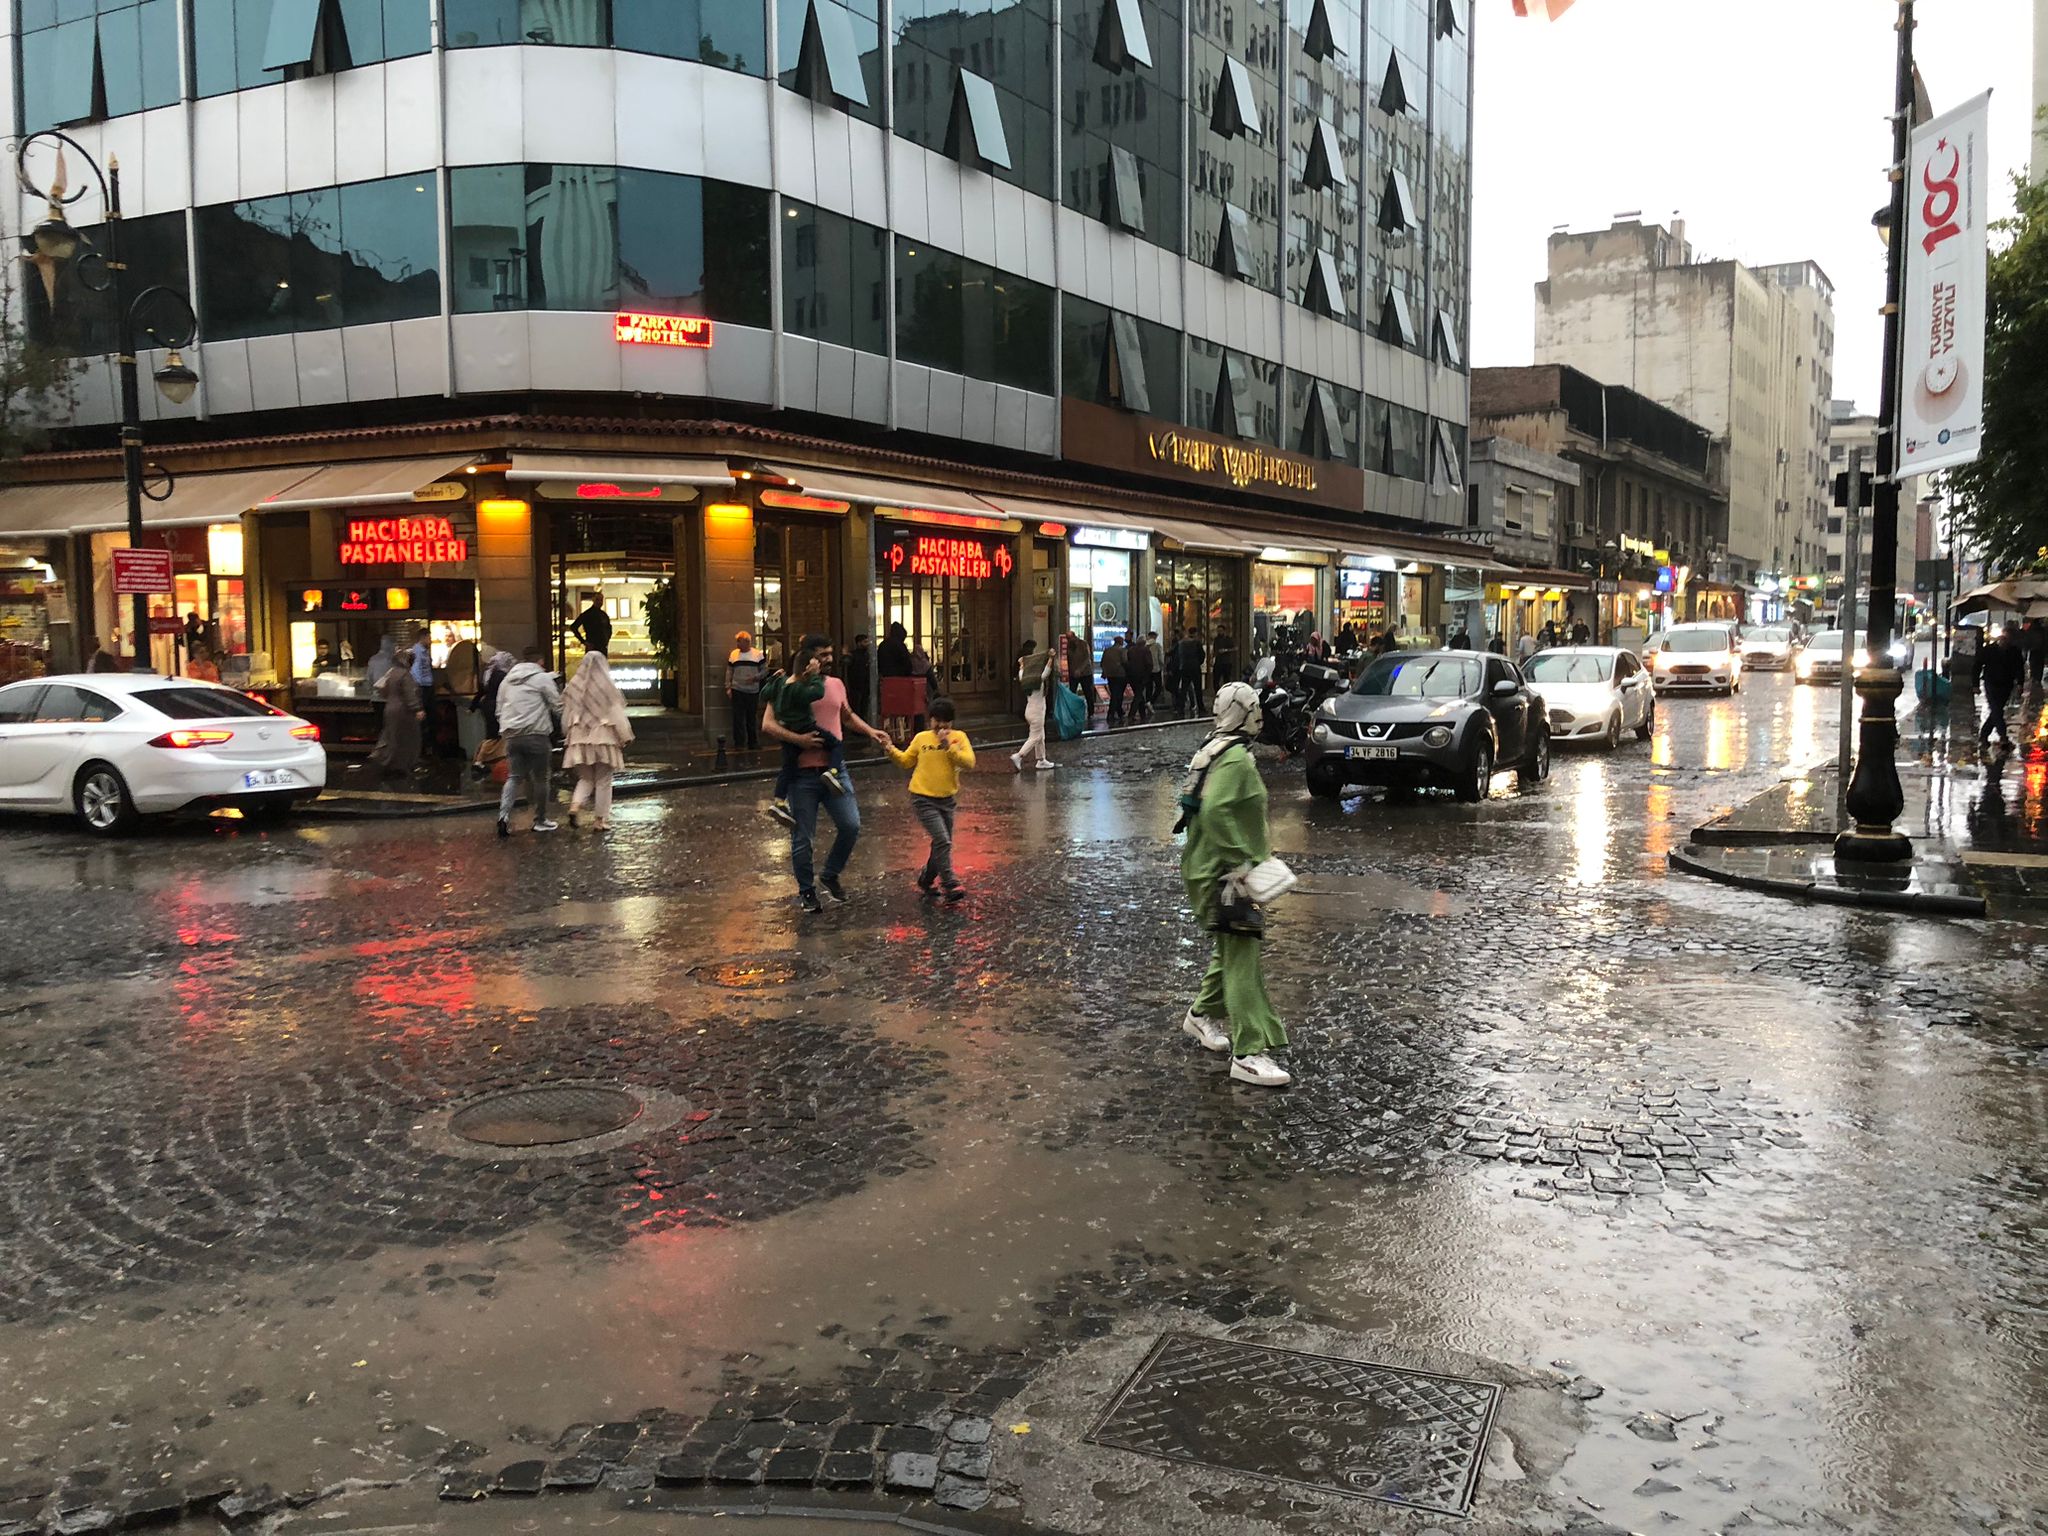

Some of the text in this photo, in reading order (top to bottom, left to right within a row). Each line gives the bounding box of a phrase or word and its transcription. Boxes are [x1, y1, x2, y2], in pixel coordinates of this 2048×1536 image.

[630, 315, 667, 329] PARK
[643, 329, 687, 343] HOTEL
[1350, 747, 1360, 757] 34
[1375, 748, 1395, 757] 2816
